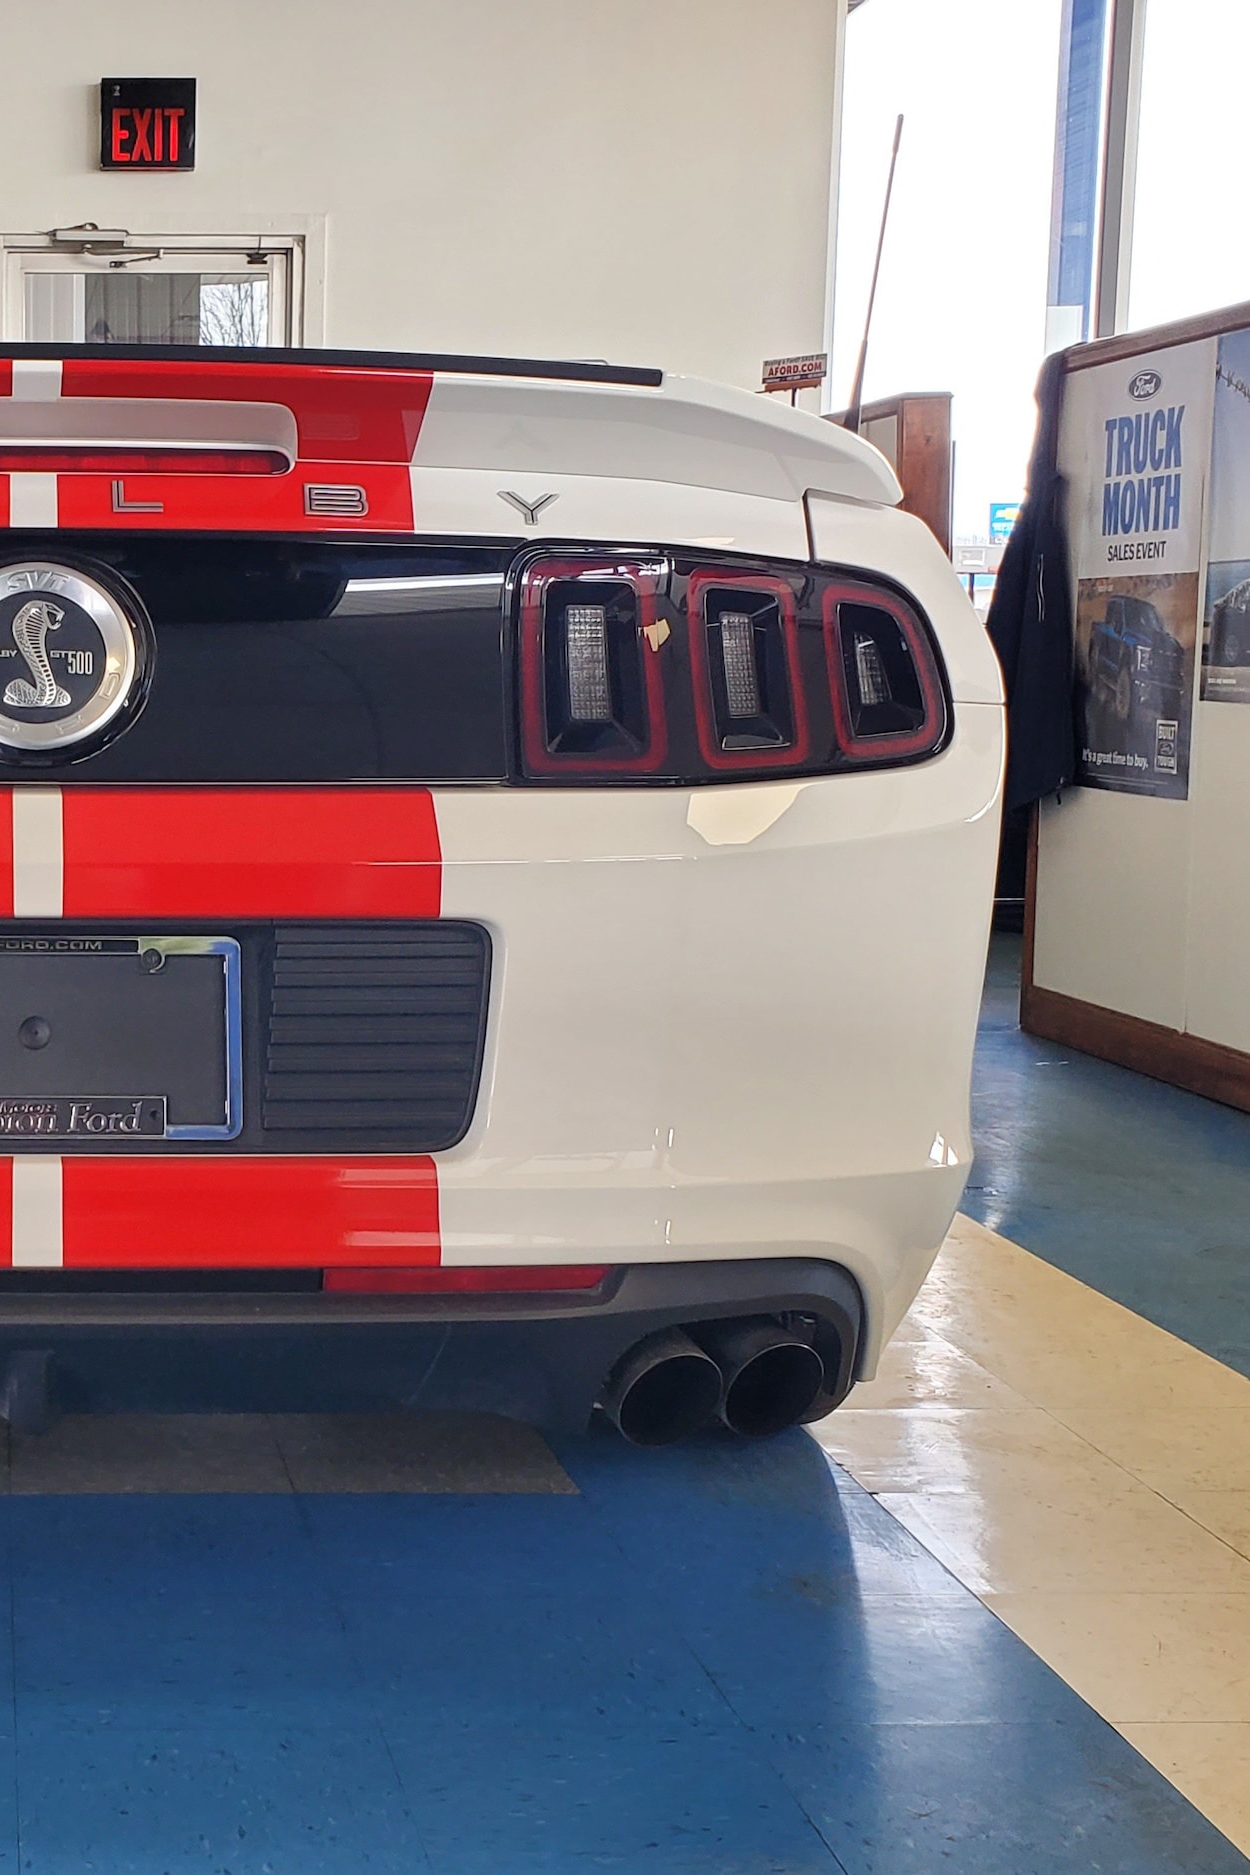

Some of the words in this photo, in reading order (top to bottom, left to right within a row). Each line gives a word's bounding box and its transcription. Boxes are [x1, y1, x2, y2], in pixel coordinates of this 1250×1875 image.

[111, 107, 185, 162] EXIT
[768, 362, 822, 376] AFORD.COM
[1133, 374, 1158, 398] Ford
[1105, 405, 1185, 478] TRUCK
[1102, 473, 1181, 536] MONTH
[1107, 543, 1135, 562] SALES
[1136, 541, 1167, 560] EVENT
[6, 569, 69, 593] SVT
[1158, 725, 1175, 740] BUILT
[1096, 751, 1112, 766] great
[1112, 750, 1126, 766] time
[1127, 754, 1134, 767] to
[1157, 755, 1175, 768] TOUGH
[66, 1101, 143, 1133] Ford
